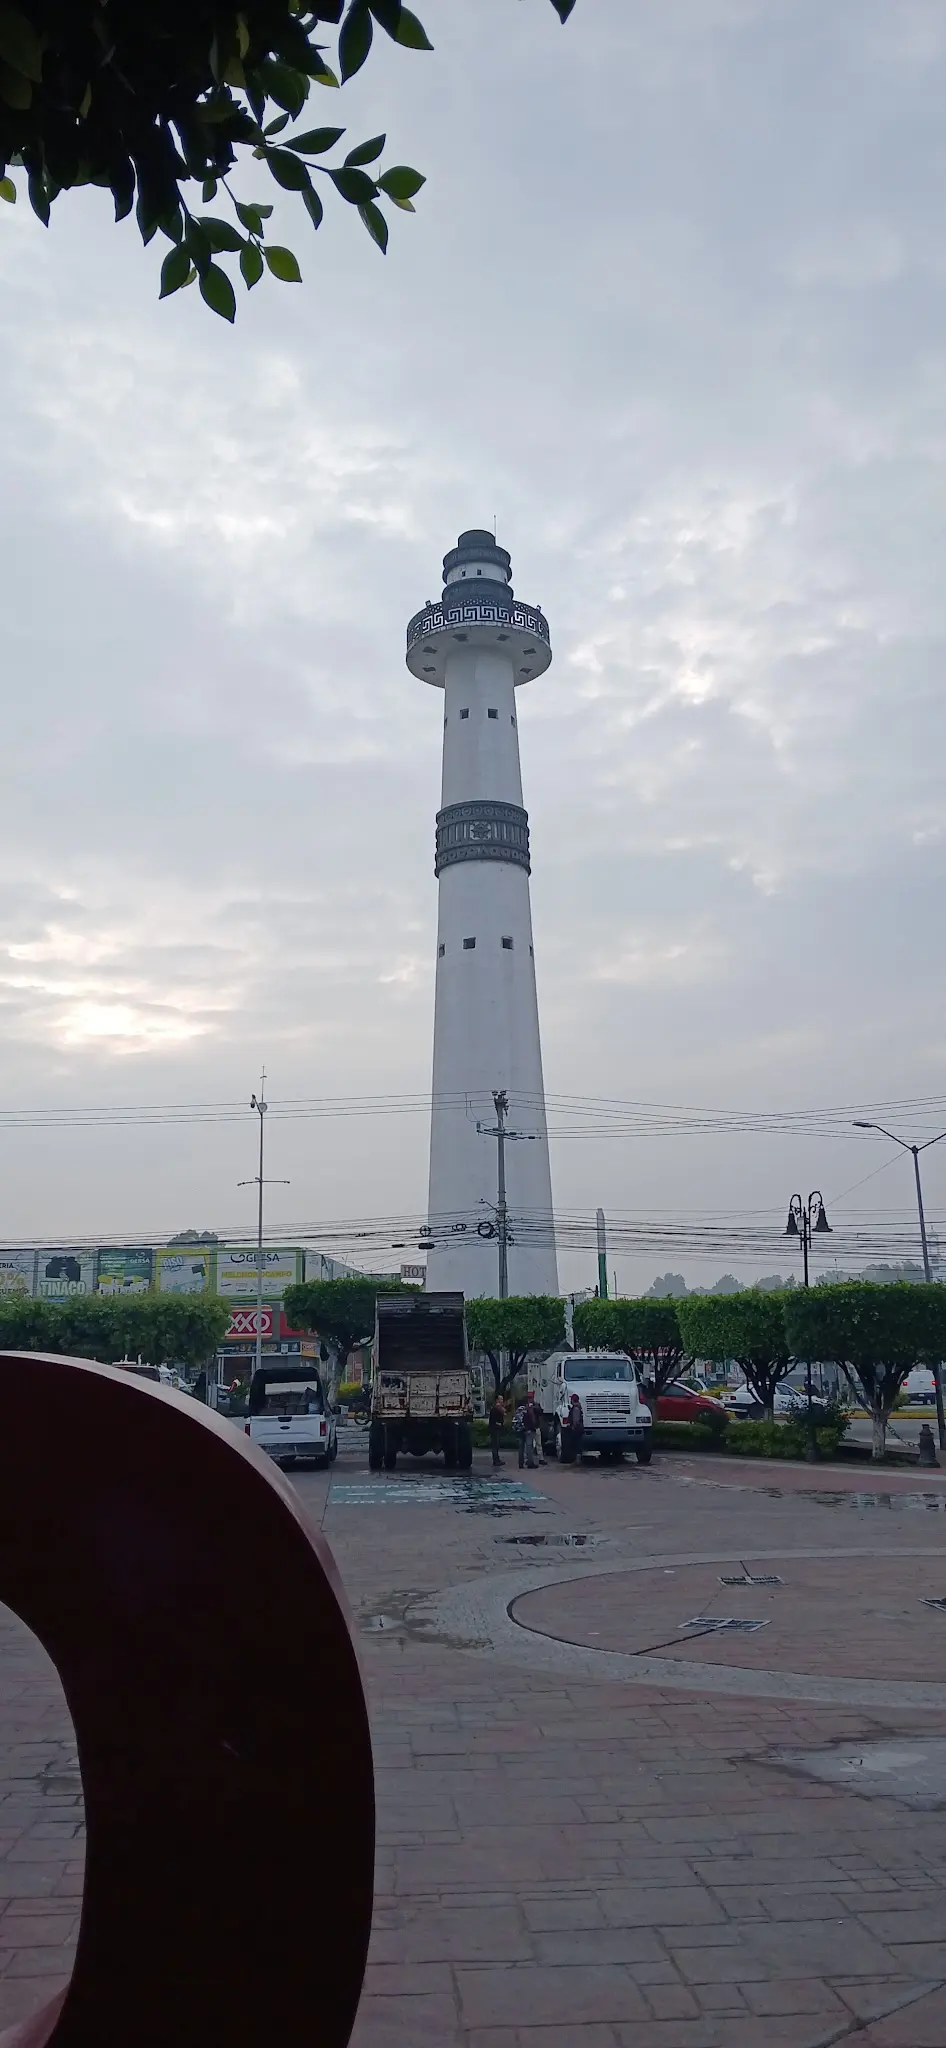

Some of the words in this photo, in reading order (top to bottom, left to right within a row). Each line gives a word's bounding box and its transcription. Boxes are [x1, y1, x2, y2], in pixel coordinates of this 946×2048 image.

[245, 1254, 280, 1262] GESA
[40, 1281, 86, 1296] TINACO
[226, 1311, 271, 1333] XXO
